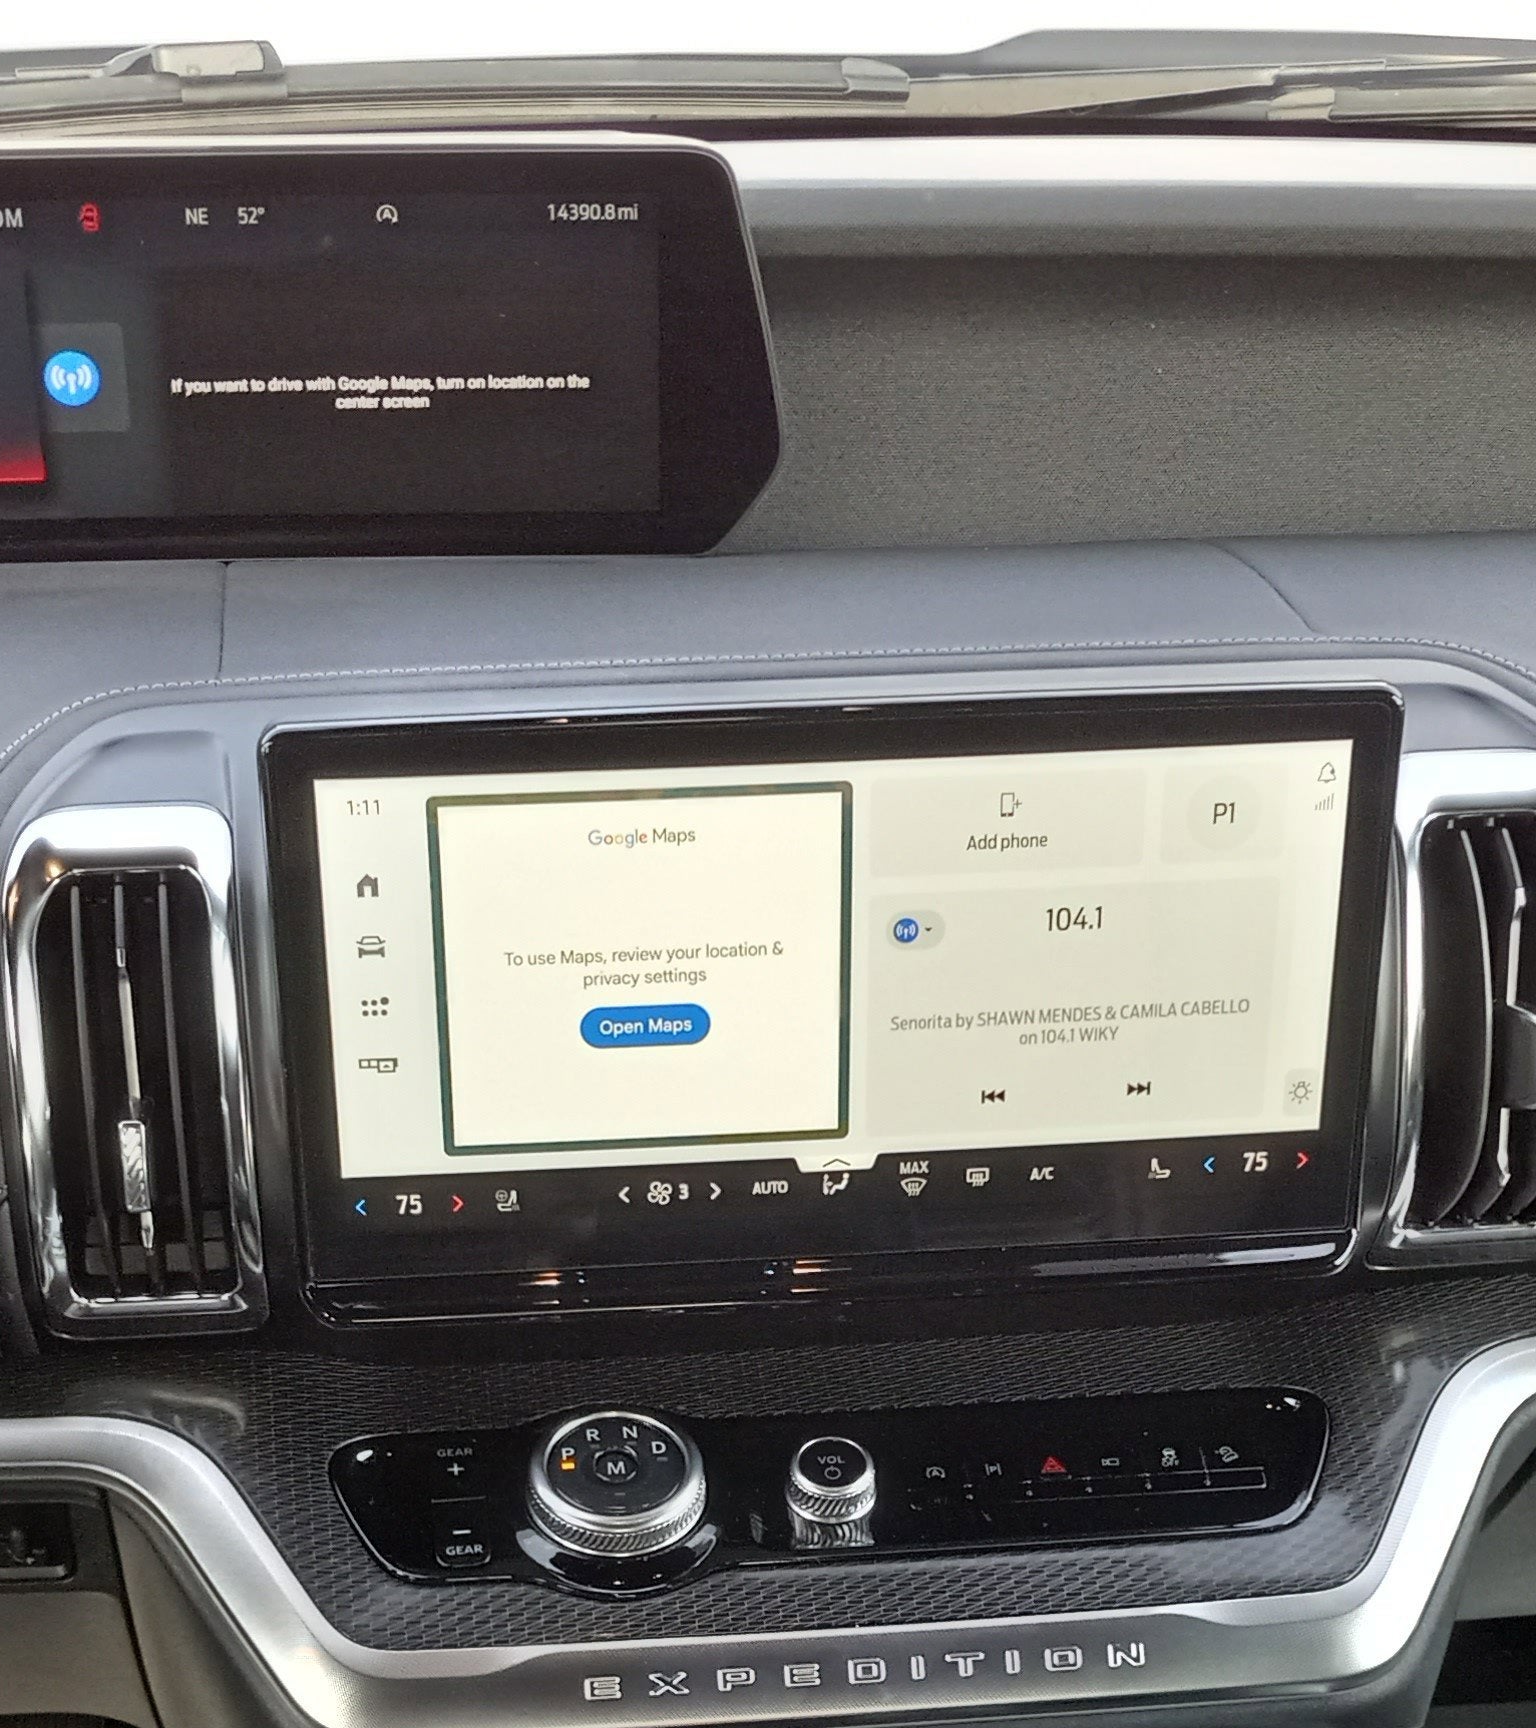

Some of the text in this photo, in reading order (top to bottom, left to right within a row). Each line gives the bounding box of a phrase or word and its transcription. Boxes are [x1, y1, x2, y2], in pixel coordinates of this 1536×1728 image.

[185, 207, 209, 225] NE
[171, 378, 183, 393] If
[184, 382, 212, 397] you
[214, 379, 249, 393] want
[250, 379, 265, 392] to
[267, 377, 304, 392] drive
[305, 376, 336, 391] with
[337, 375, 389, 394] Google
[436, 376, 465, 391] turn
[466, 377, 486, 390] on
[488, 374, 544, 390] location
[545, 376, 565, 389] on
[567, 374, 590, 389] the
[335, 396, 431, 409] center screen
[347, 798, 381, 817] 1:11
[1212, 802, 1237, 825] P1
[587, 827, 696, 849] Google Maps
[966, 832, 1048, 851] Add phone
[1046, 906, 1104, 932] 104.1
[504, 940, 784, 967] To use Maps, review your location &
[582, 968, 707, 990] privacy settings
[890, 997, 1250, 1031] Senorita by SHAWN MENDES & CAMILA CABELLO
[598, 1017, 693, 1038] Open Maps
[1018, 1025, 1120, 1045] on 104.1 WIKY
[899, 1159, 930, 1175] MAX
[1243, 1151, 1269, 1173] 75
[1029, 1166, 1054, 1181] A/C
[678, 1183, 690, 1201] 3
[751, 1180, 789, 1196] AUTO
[395, 1194, 423, 1216] 75
[586, 1429, 601, 1441] R
[622, 1426, 639, 1439] N
[436, 1447, 474, 1458] GEAR
[561, 1447, 575, 1460] P
[651, 1441, 666, 1454] D
[607, 1462, 626, 1475] M
[817, 1455, 845, 1464] VOL
[445, 1544, 484, 1556] GEAR
[583, 1641, 1146, 1701] EXPEDITION
